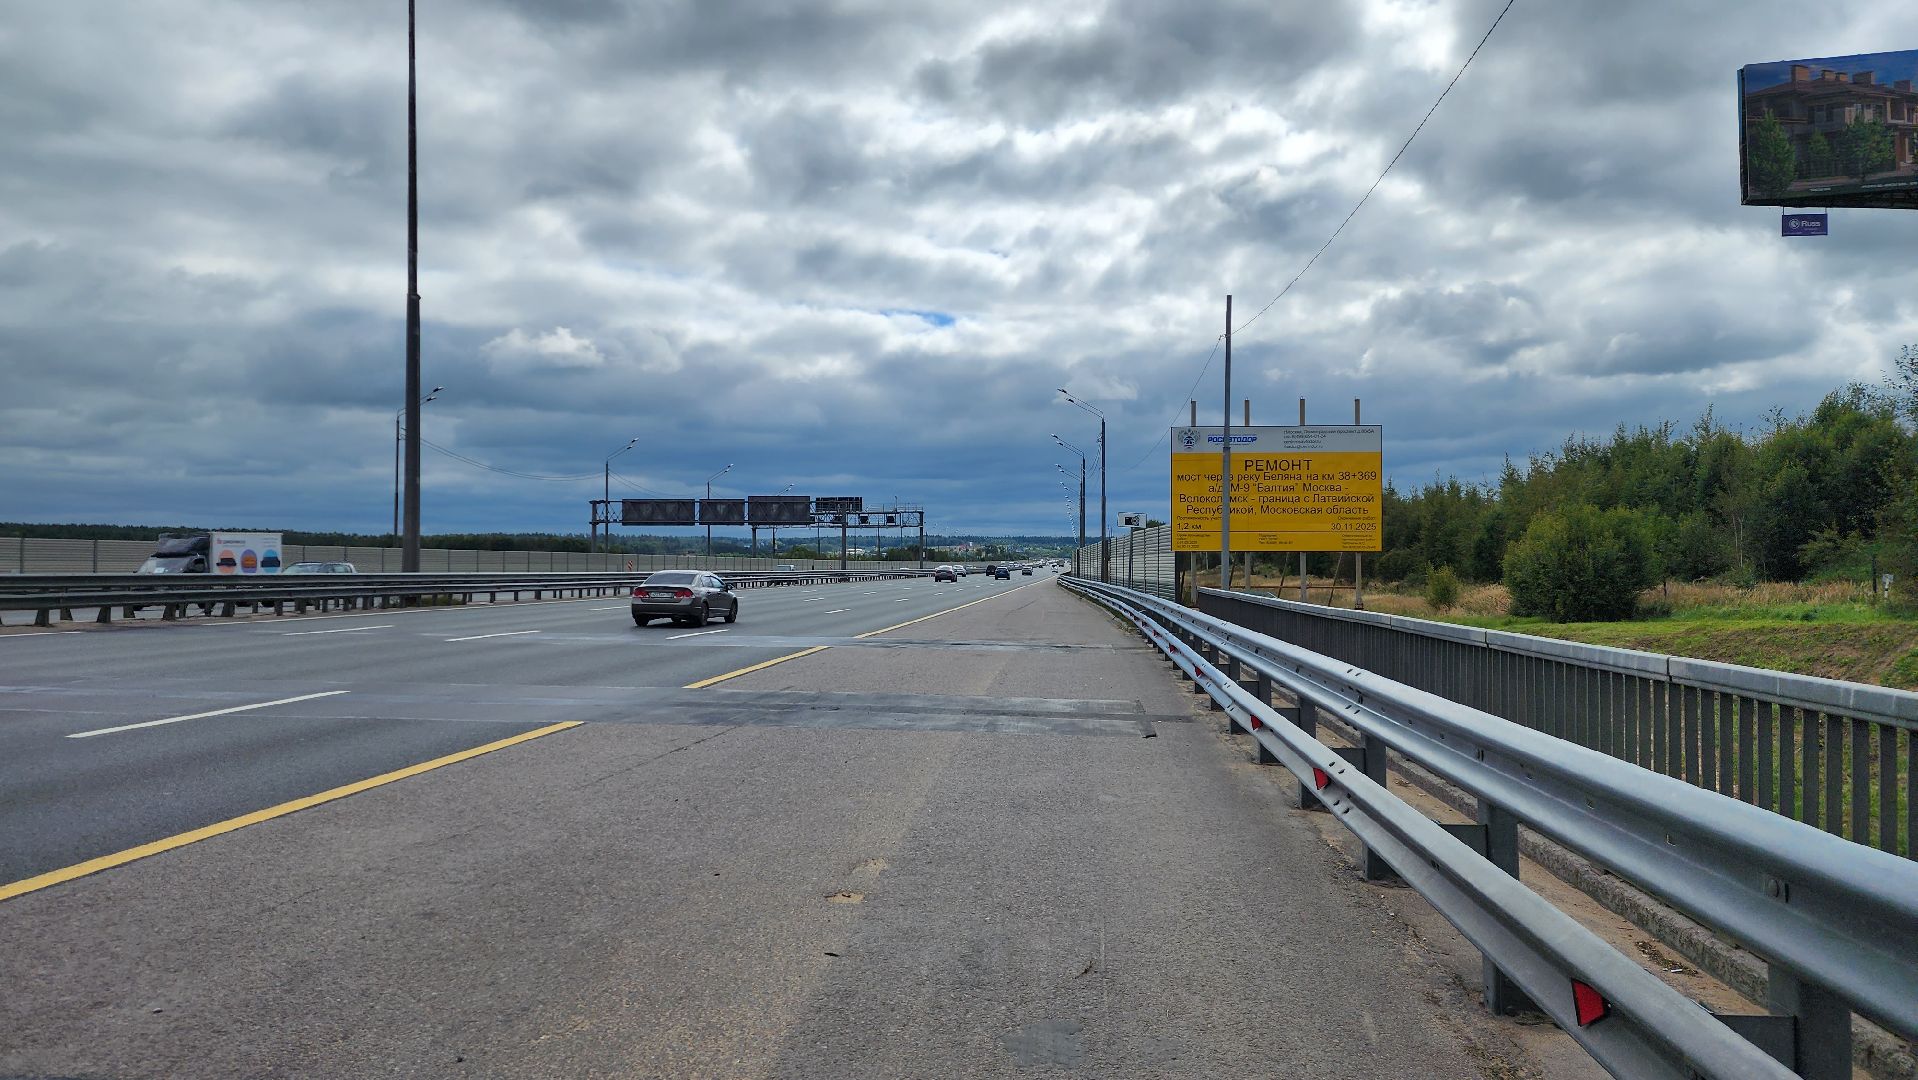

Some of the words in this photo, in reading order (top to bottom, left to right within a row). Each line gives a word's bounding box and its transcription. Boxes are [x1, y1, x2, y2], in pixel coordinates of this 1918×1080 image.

[1244, 460, 1312, 471] РЕМОНТ
[1177, 473, 1201, 481] мост
[1204, 473, 1234, 483] черз
[1237, 473, 1259, 483] реку
[1264, 472, 1302, 480] Беляна
[1338, 471, 1376, 481] 38+369
[1230, 484, 1250, 492] М-9
[1303, 484, 1341, 492] Москва
[1179, 494, 1248, 503] Волоколмск
[1259, 496, 1300, 505] граница
[1313, 494, 1375, 503] Латвийской
[1187, 505, 1257, 516] Респубикой,
[1260, 506, 1322, 515] Московская
[1325, 505, 1368, 515] область
[1177, 523, 1189, 531] 1,2
[1331, 523, 1376, 531] 30.11.2025
